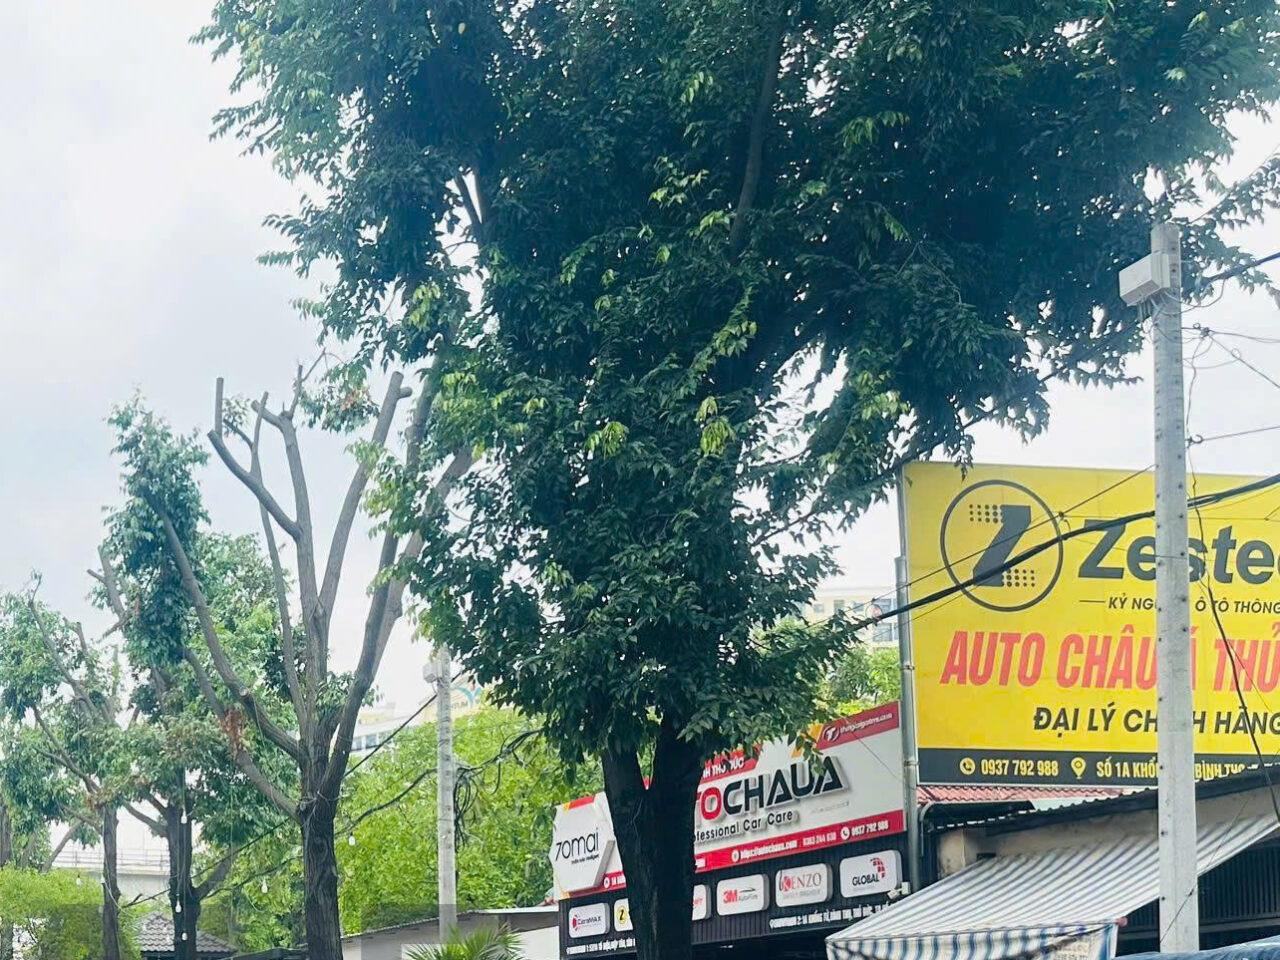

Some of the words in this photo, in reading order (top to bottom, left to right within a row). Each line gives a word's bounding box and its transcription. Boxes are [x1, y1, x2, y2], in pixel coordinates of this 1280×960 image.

[1078, 519, 1280, 584] Zeste
[939, 630, 1046, 688] AUTO
[1056, 623, 1158, 690] CHÂU
[1033, 706, 1080, 738] ĐẠI
[1088, 702, 1116, 731] LÝ
[980, 759, 1010, 776] 0937
[1011, 760, 1036, 776] 792
[1037, 762, 1059, 777] 988
[1115, 761, 1131, 778] 1A
[697, 756, 845, 820] OCHAUA
[696, 822, 741, 843] fessional
[743, 816, 763, 831] Car
[767, 810, 794, 826] Care
[555, 828, 600, 862] 70mai
[723, 889, 738, 904] 3M
[852, 873, 881, 888] GLOBAL
